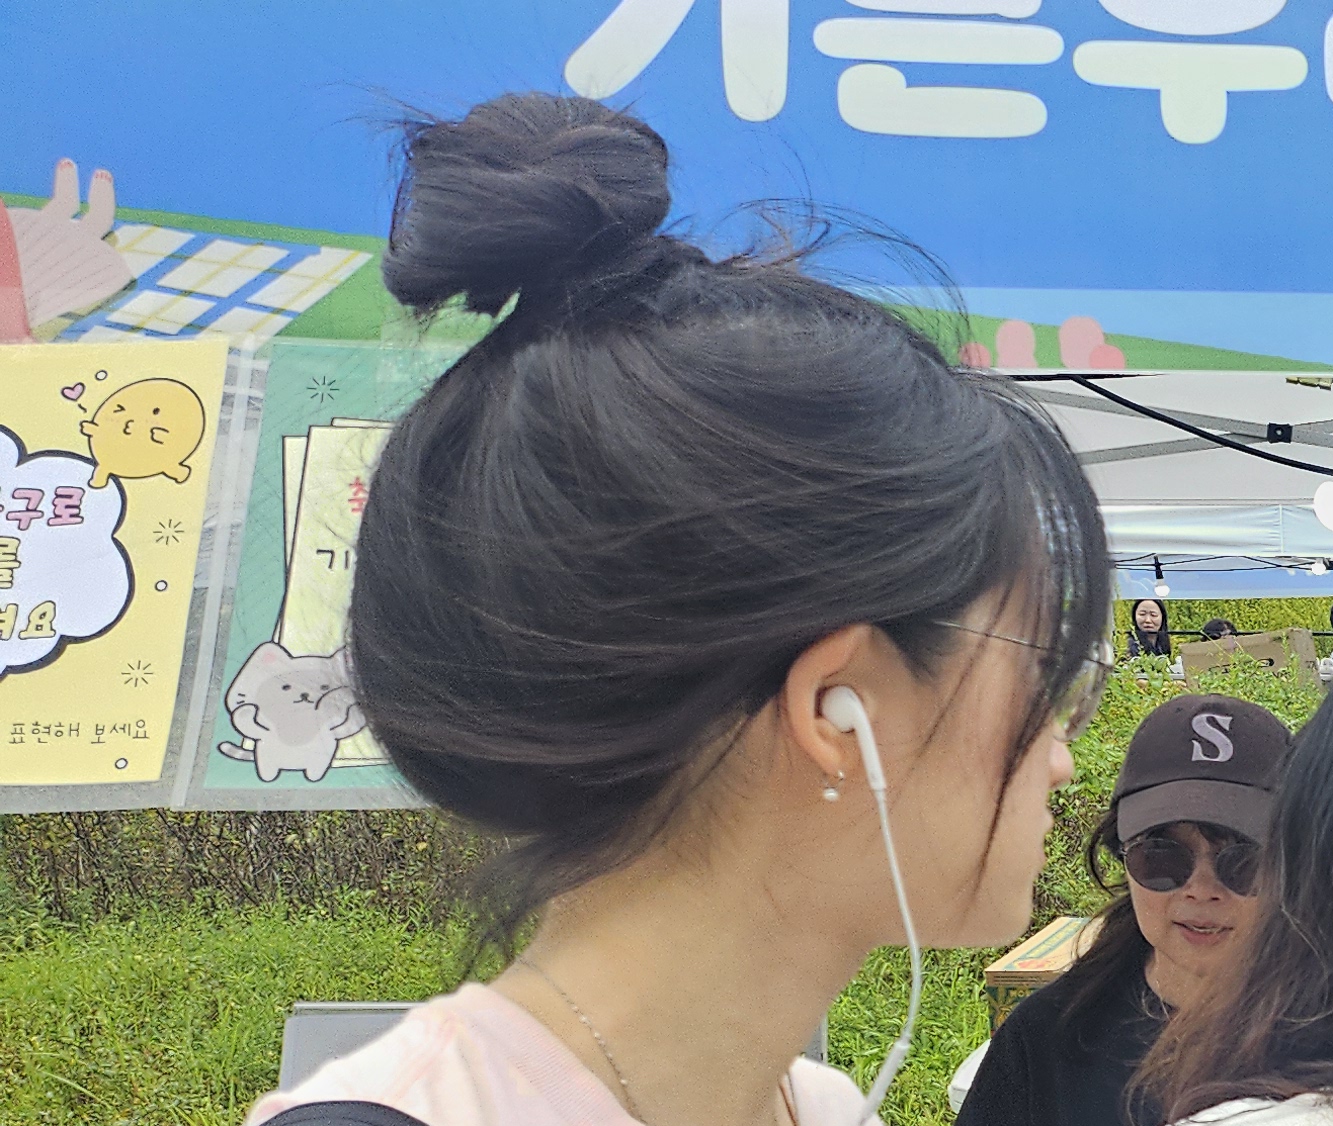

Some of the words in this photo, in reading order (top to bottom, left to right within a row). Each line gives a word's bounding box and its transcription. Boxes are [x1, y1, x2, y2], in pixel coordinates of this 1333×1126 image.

[0, 486, 86, 531] 구로
[9, 722, 81, 745] 표현해
[90, 719, 150, 745] 보세요
[1190, 712, 1235, 763] S
